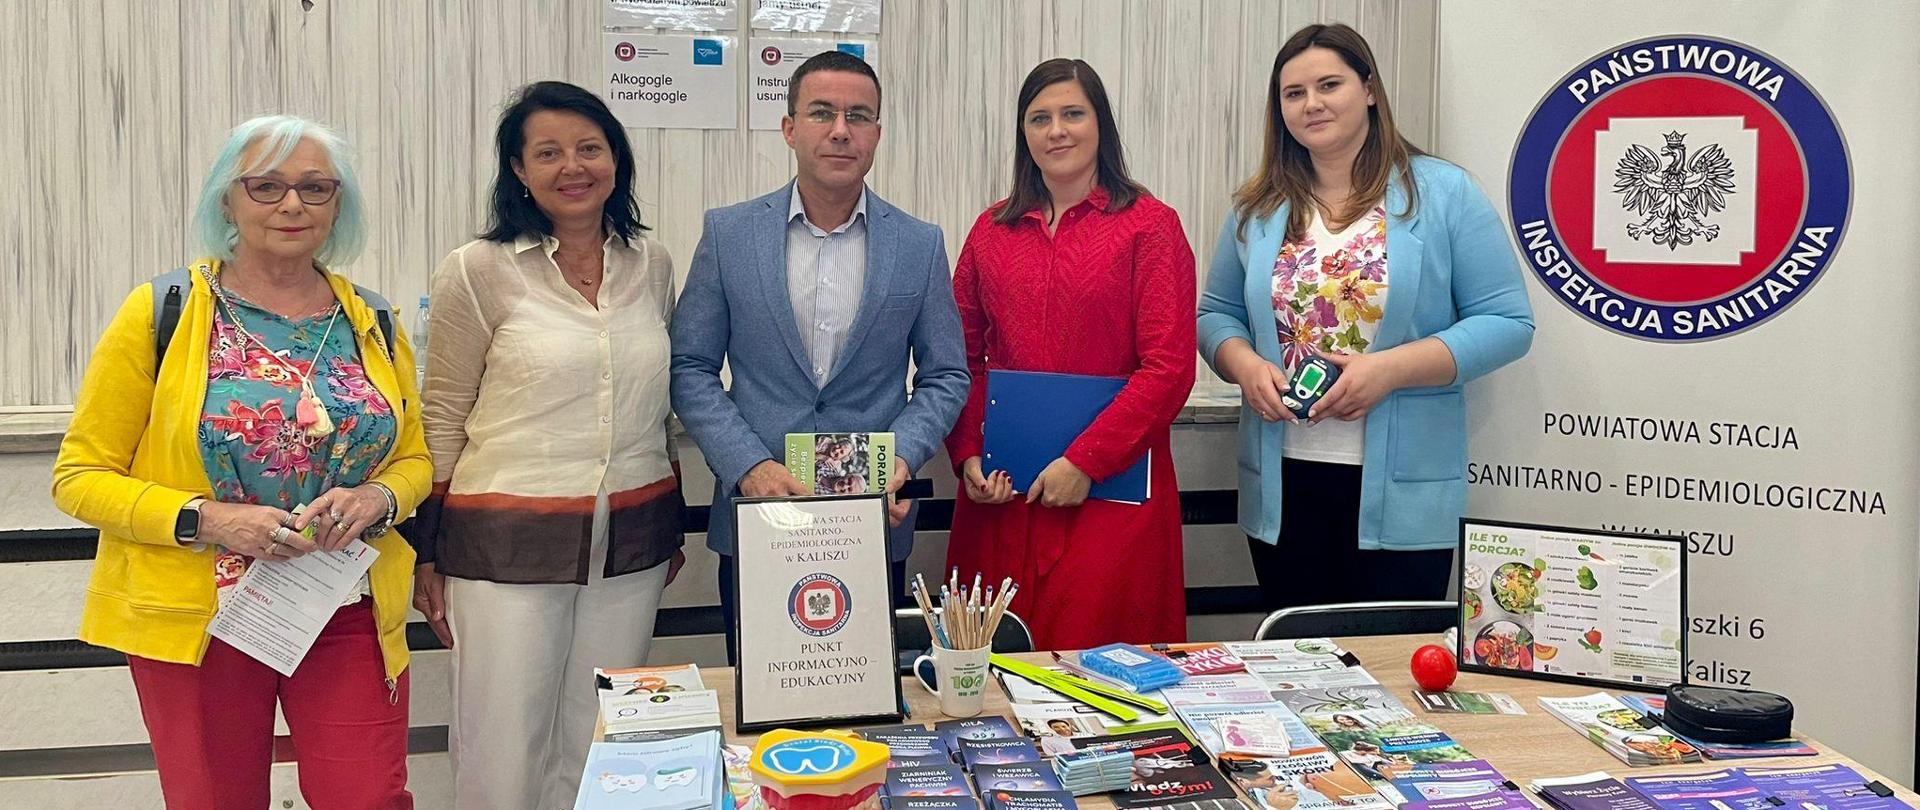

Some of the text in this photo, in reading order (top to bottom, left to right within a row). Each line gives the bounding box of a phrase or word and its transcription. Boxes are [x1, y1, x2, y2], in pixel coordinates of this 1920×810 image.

[611, 73, 673, 88] Alkogogle
[1568, 44, 1785, 104] PAŃSTWOWA
[757, 76, 790, 87] Instru
[611, 90, 687, 103] i narkogogle
[757, 90, 789, 101] usuni
[1521, 219, 1835, 335] INSPEKCJA SANITARNA
[1544, 412, 1799, 450] POWIATOWA STACJA
[1468, 463, 1602, 493] SANITARNO
[1626, 474, 1887, 515] EPIDEMIOLOGICZNA
[829, 515, 862, 524] STACJA
[770, 538, 862, 550] EPIDEMIOLOGICZNA
[1469, 532, 1508, 543] ILE TO
[797, 551, 849, 562] KALISZU
[1469, 543, 1526, 557] PORCJA?
[1687, 614, 1765, 640] szki 6
[800, 641, 844, 654] PUNKT
[768, 656, 868, 673] INFORMACYJNO
[780, 672, 866, 689] EDUKACYJNY
